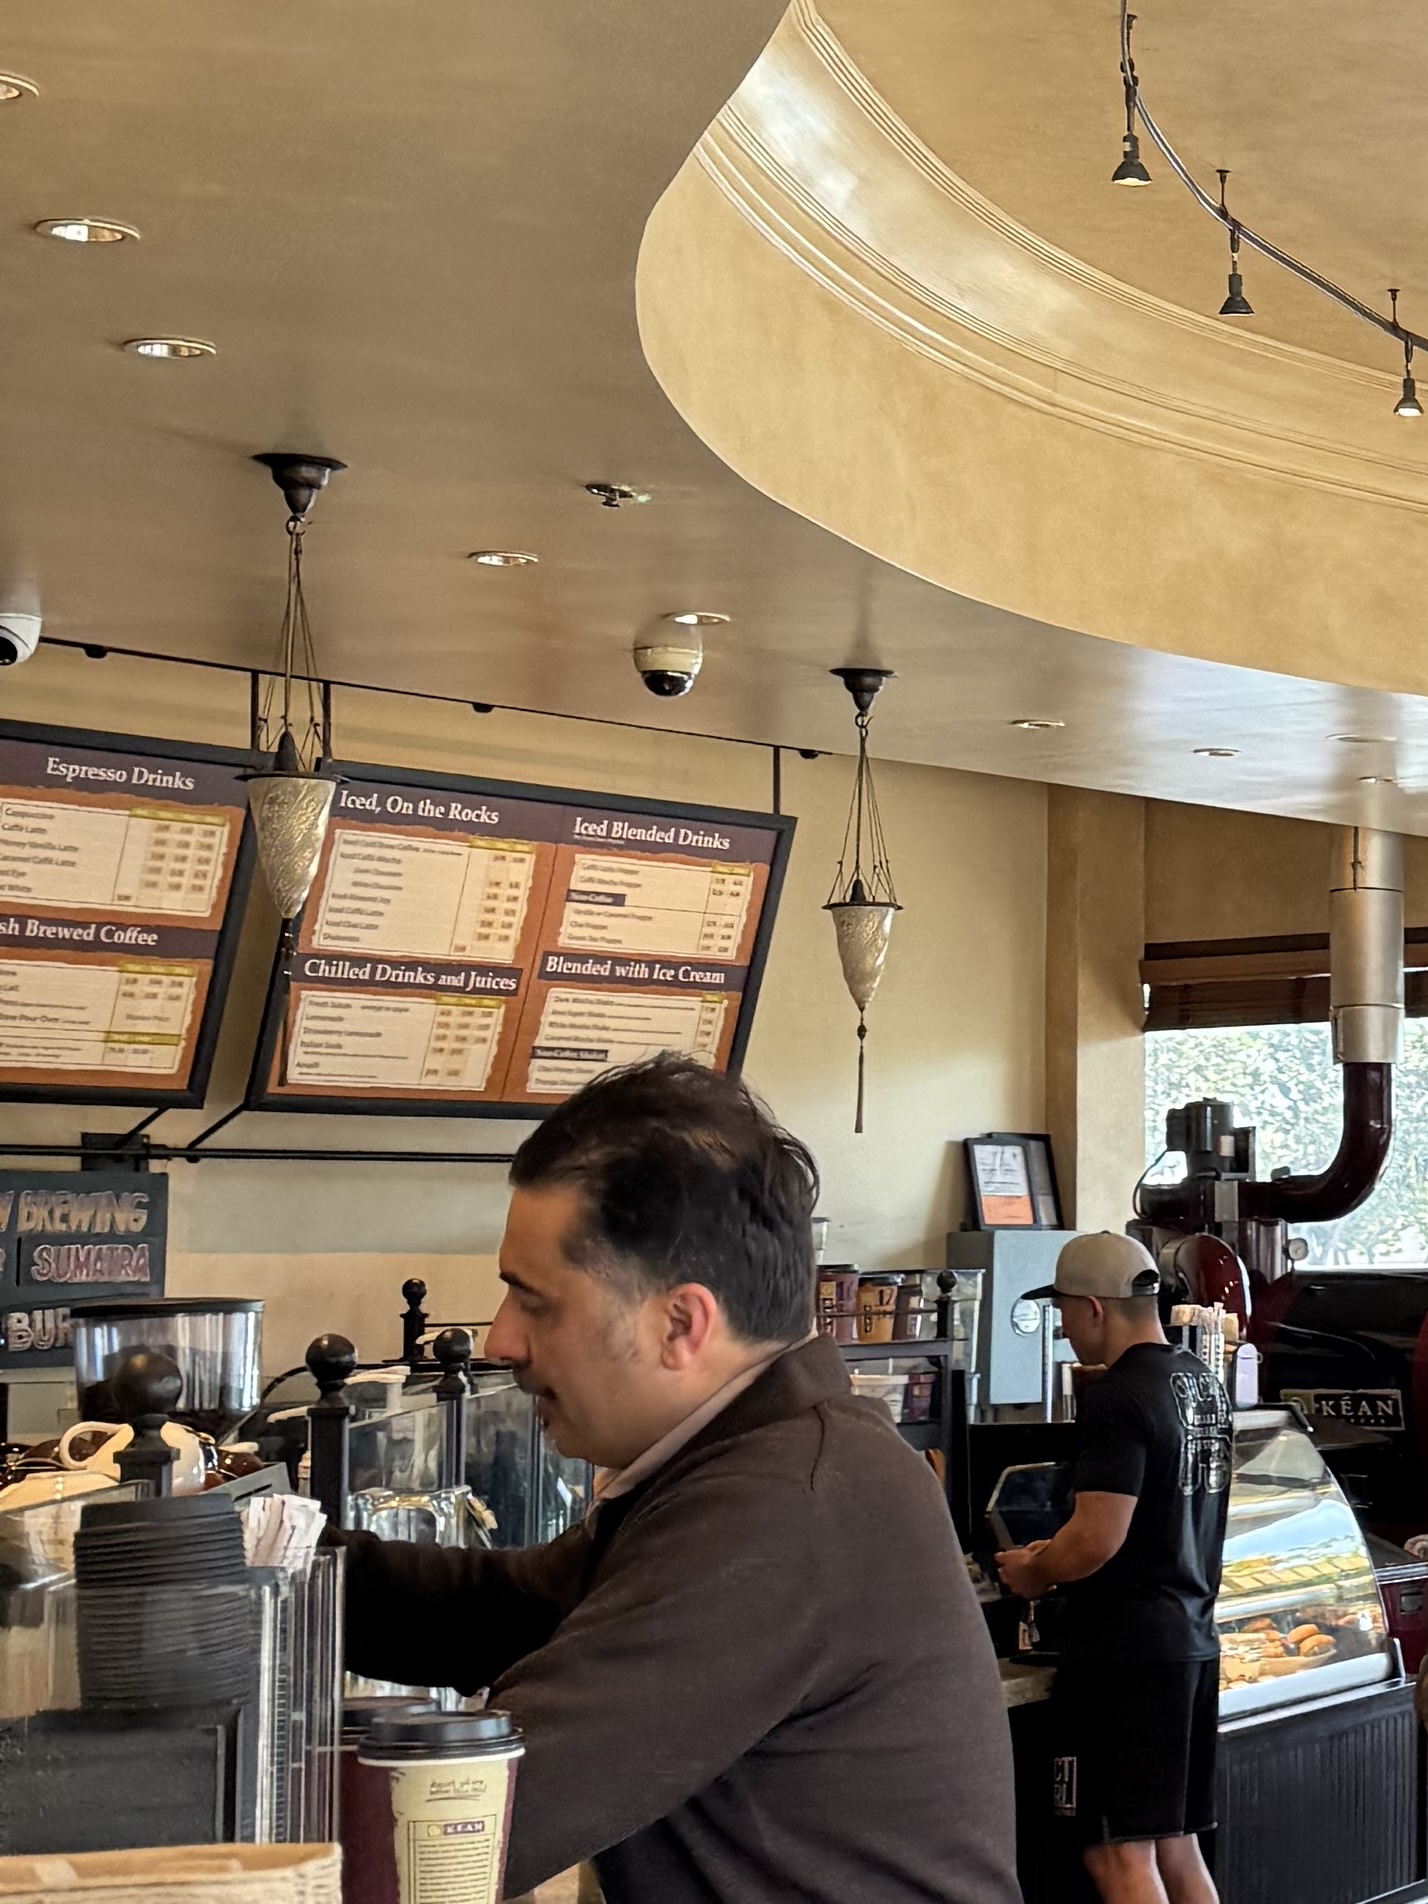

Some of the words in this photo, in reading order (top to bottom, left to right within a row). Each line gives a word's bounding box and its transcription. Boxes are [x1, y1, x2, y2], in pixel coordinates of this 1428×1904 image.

[46, 757, 127, 782] Espresso
[131, 767, 195, 791] Drinks
[339, 790, 381, 814] Iced,
[386, 796, 413, 815] On
[418, 799, 445, 818] the
[448, 803, 499, 825] Rocks
[574, 817, 608, 836] Iced
[611, 821, 675, 844] Blended
[678, 829, 731, 850] Drinks
[25, 919, 96, 941] Brewed
[100, 925, 158, 945] Coffee
[304, 959, 370, 980] Chilled
[375, 964, 435, 985] Drinks
[438, 972, 464, 987] and
[465, 970, 517, 991] Juices
[545, 956, 612, 976] Blended
[615, 962, 649, 979] with
[652, 964, 676, 981] Ice
[678, 967, 725, 984] Cream
[17, 1190, 149, 1234] BREWING
[31, 1244, 151, 1283] SUMATRA
